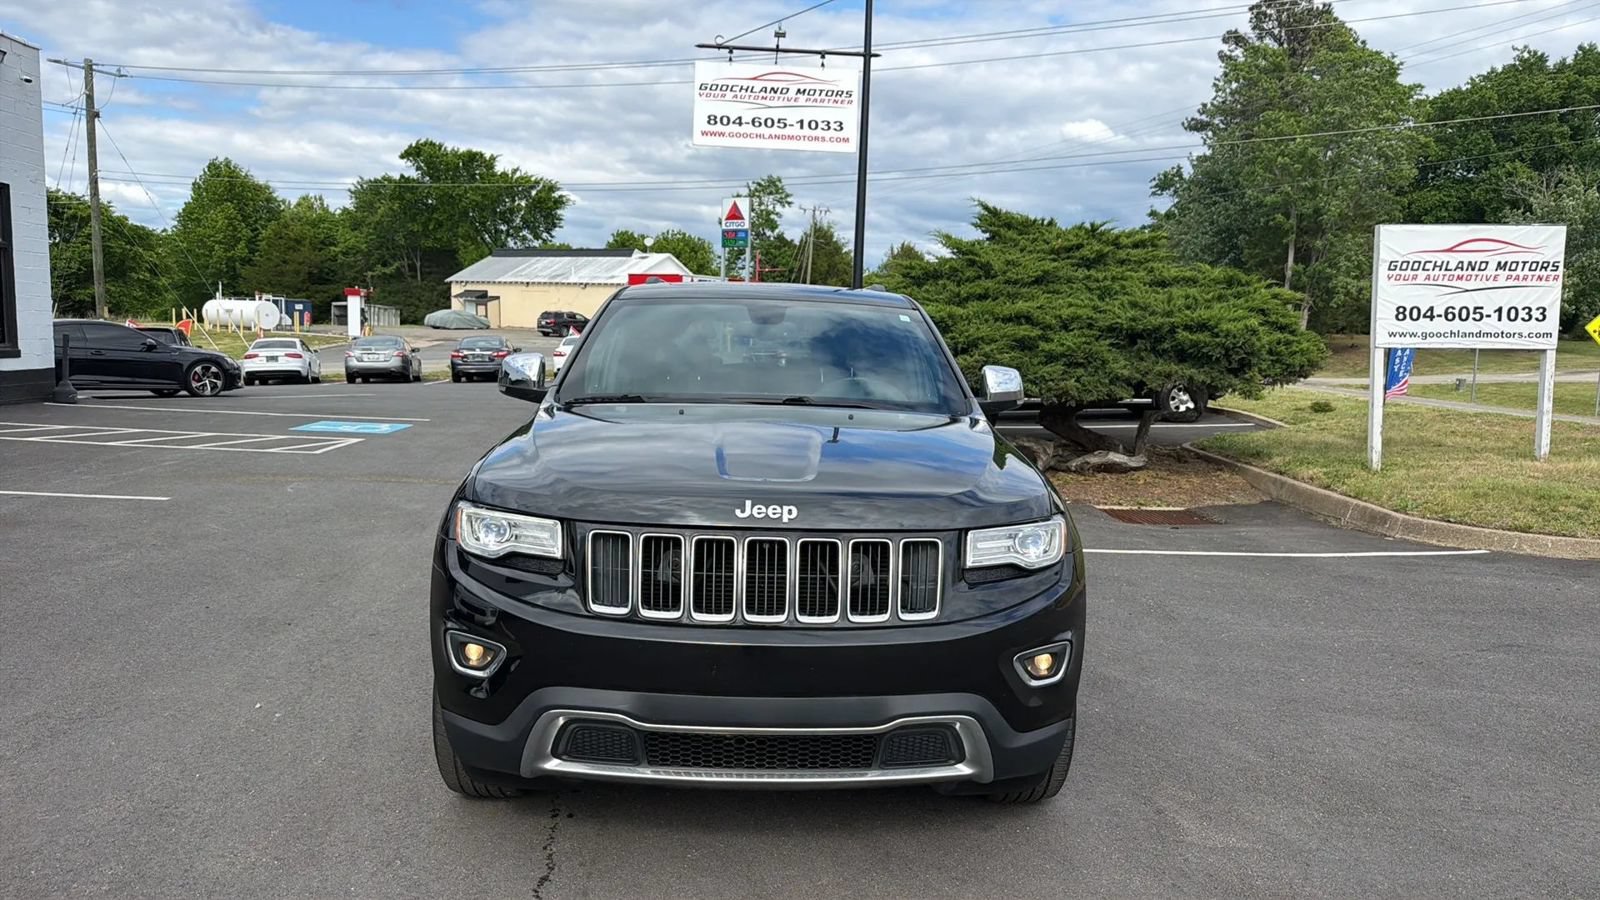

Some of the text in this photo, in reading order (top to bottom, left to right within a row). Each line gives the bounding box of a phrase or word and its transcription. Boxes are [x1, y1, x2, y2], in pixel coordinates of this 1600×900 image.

[698, 83, 854, 98] GOOCHLAND MOTORS
[731, 94, 801, 103] AUTOMOTIVE
[805, 97, 854, 105] PARTNER
[706, 114, 844, 132] 804-605-1033
[700, 130, 850, 143] WWW.GOOCHLANDMOTORS.COM
[1387, 260, 1561, 272] GOOCHLAND MOTORS
[1386, 274, 1560, 282] YOUR AUTOMOTIVE PARTNER
[1395, 305, 1547, 322] 804-605-1033
[1388, 330, 1553, 341] www.goochlandmotors.com
[735, 500, 798, 523] Jeep
